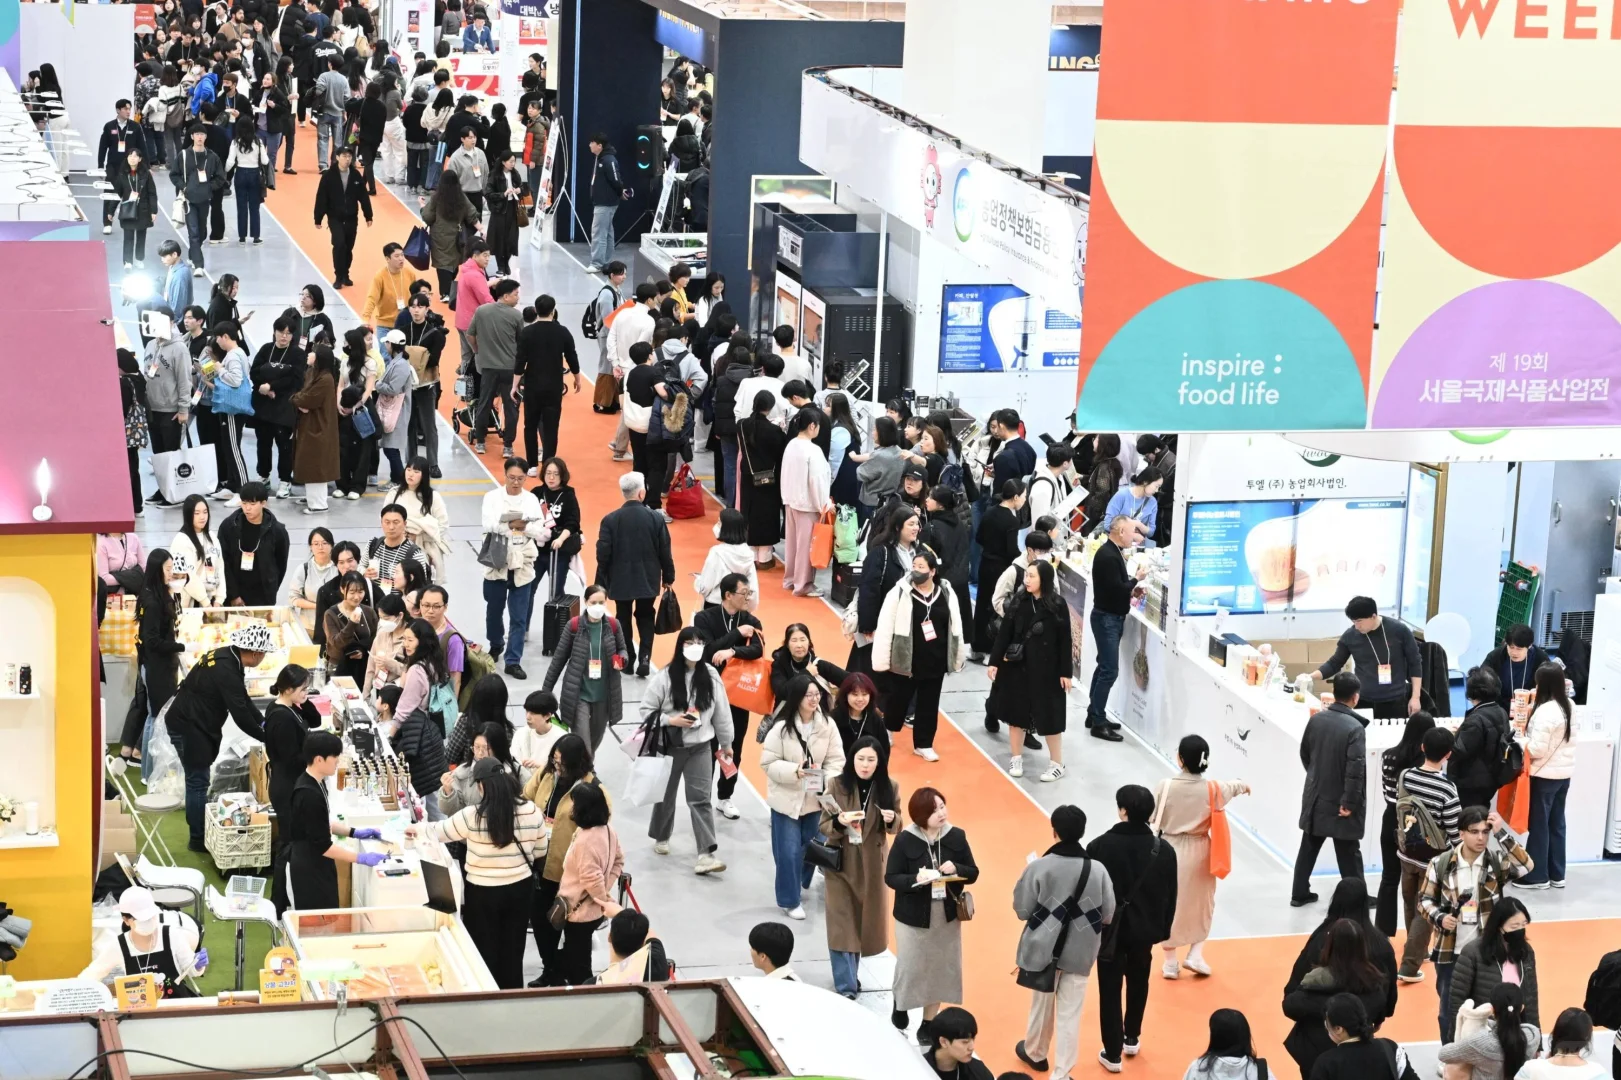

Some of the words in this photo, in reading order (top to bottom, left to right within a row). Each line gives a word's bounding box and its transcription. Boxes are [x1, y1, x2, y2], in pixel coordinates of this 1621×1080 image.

[1446, 0, 1621, 40] WEE
[1181, 352, 1265, 382] inspire
[1488, 352, 1506, 373] 제
[1513, 352, 1549, 373] 19회
[1178, 381, 1236, 405] food
[1241, 381, 1280, 405] life
[1418, 378, 1610, 403] 서울국제식품산업전
[1246, 479, 1265, 491] 투엘
[1268, 479, 1285, 490] (주)
